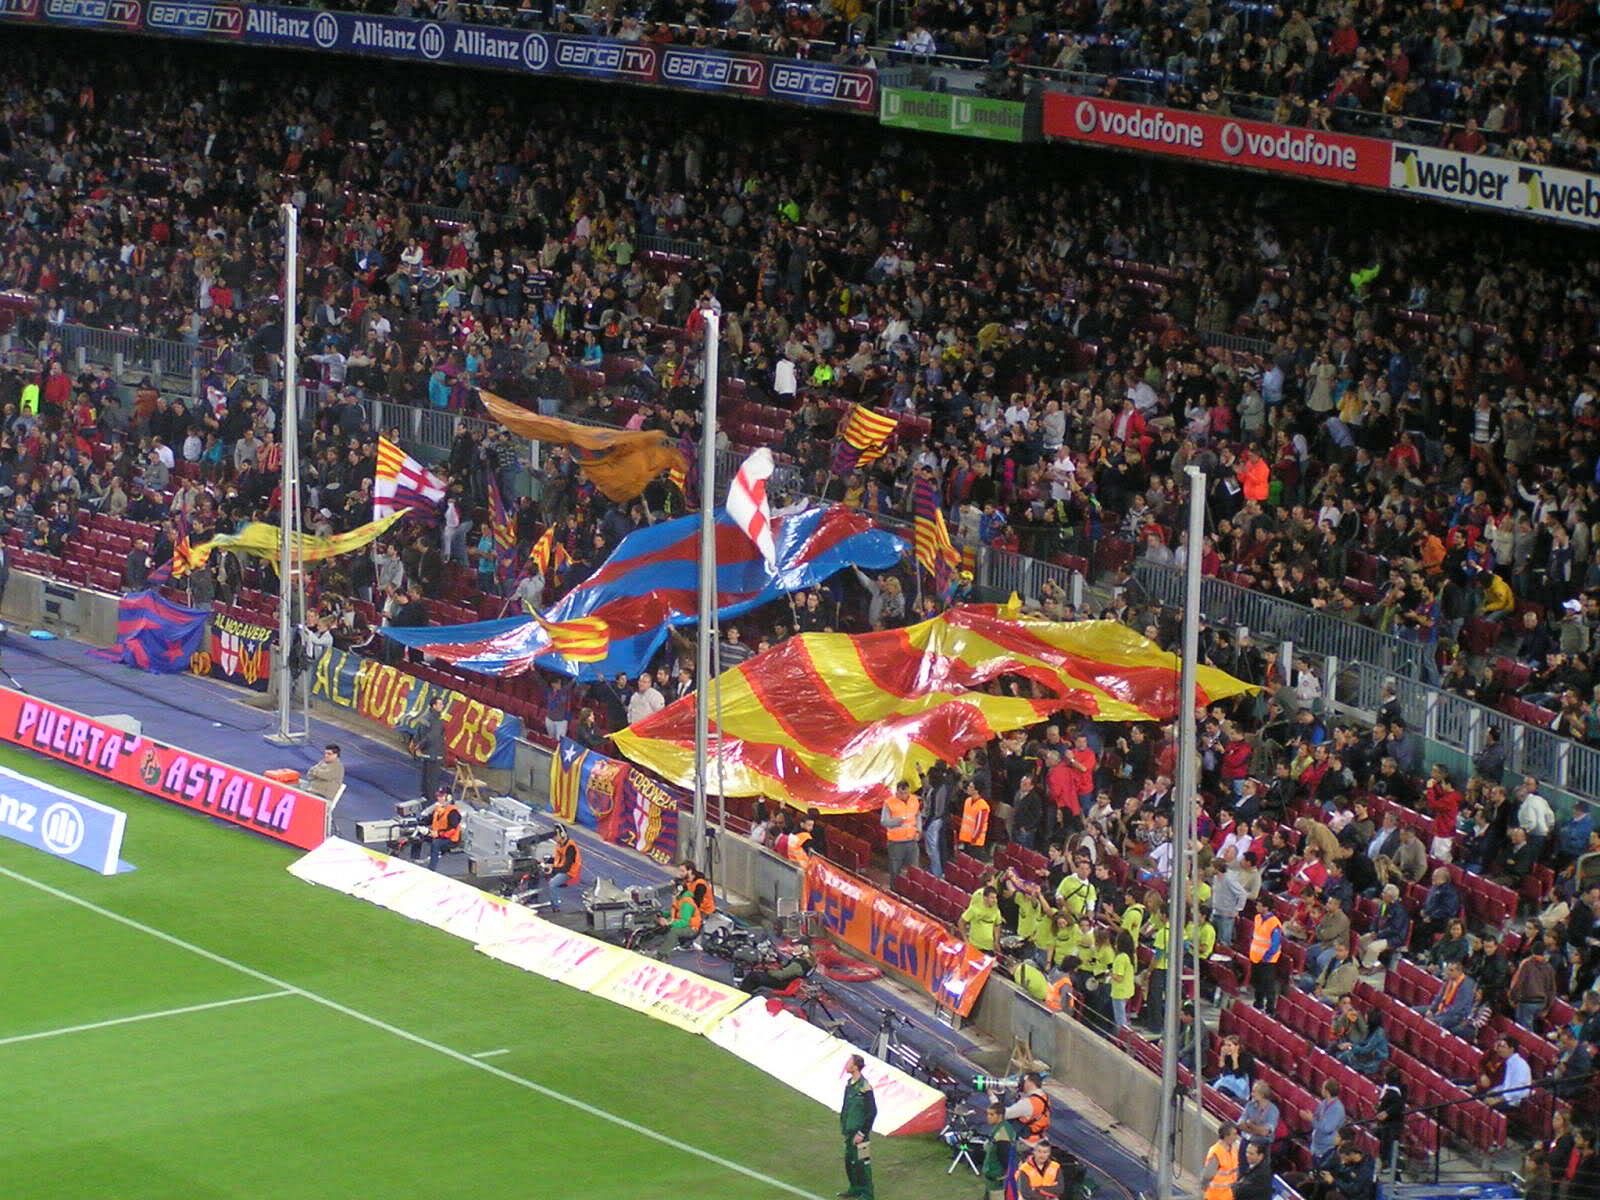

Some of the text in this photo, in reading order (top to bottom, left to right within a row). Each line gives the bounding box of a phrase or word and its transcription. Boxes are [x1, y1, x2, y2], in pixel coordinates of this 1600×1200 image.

[112, 2, 136, 19] TV
[214, 11, 240, 29] TV
[247, 9, 310, 38] Allianz
[352, 21, 417, 50] Allianz
[454, 29, 519, 60] Allianz
[625, 51, 651, 70] TV
[733, 62, 758, 83] TV
[842, 78, 869, 97] TV
[903, 99, 947, 120] media
[974, 108, 1023, 128] media
[1100, 109, 1204, 147] vodafone
[1250, 130, 1356, 170] vodafone
[1417, 157, 1509, 200] weber
[213, 612, 272, 642] ALMOGAVERS
